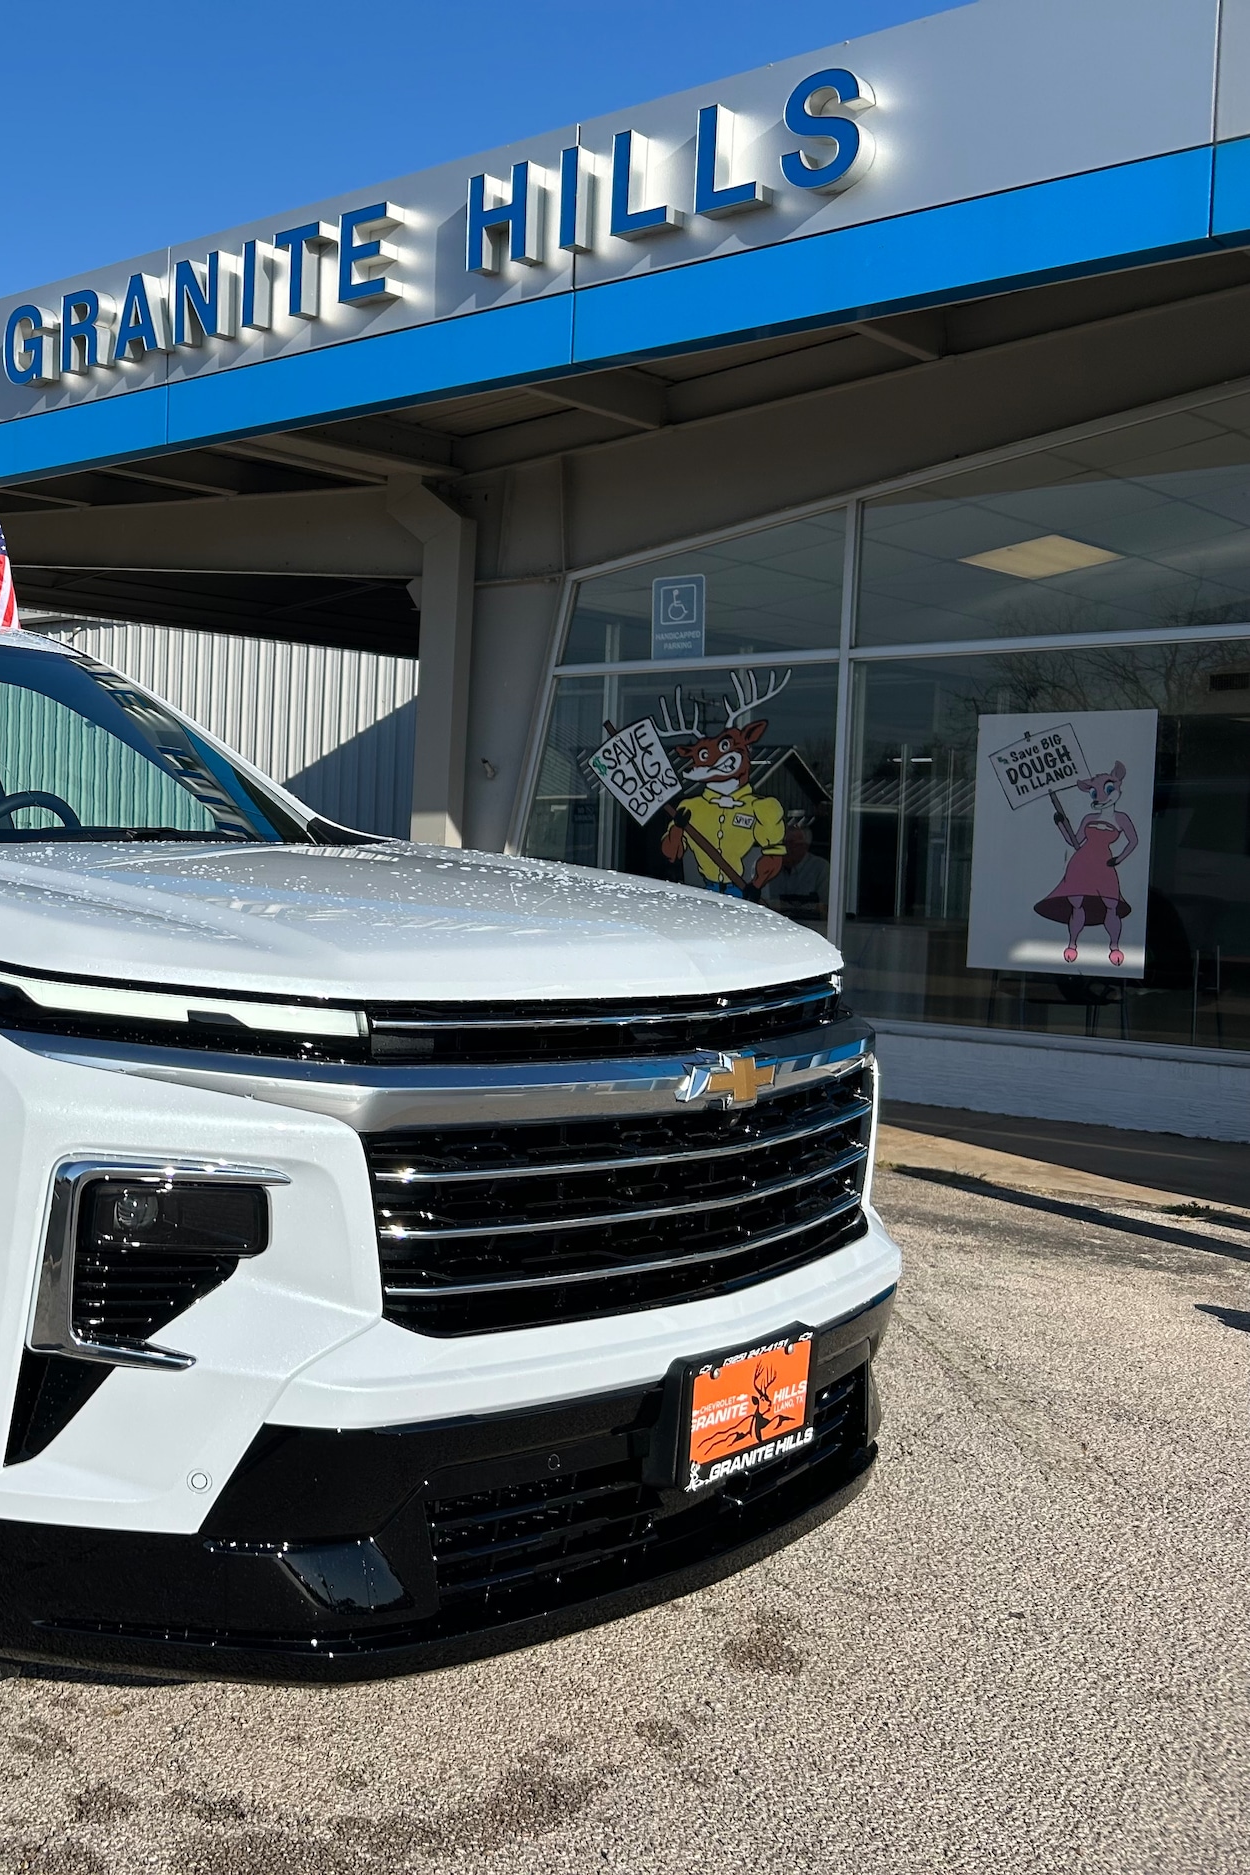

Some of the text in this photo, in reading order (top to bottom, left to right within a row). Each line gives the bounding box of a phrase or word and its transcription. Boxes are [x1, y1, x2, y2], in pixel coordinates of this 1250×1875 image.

[3, 68, 875, 387] GRANITE HILLS
[655, 631, 701, 640] HANDICAPPED
[663, 641, 692, 650] PARKING
[602, 724, 654, 770] SAVE
[1010, 745, 1040, 762] Save
[1040, 734, 1062, 750] BIG
[610, 749, 661, 796] BIG
[1005, 744, 1072, 785] DOUGH
[1015, 762, 1078, 796] in LLANO!
[628, 768, 678, 817] BUCKS
[700, 1395, 736, 1414] CHEVROLET
[773, 1380, 807, 1404] HILLS
[773, 1395, 804, 1414] LLANO, TX
[709, 1427, 814, 1481] GRANITE HILLS
